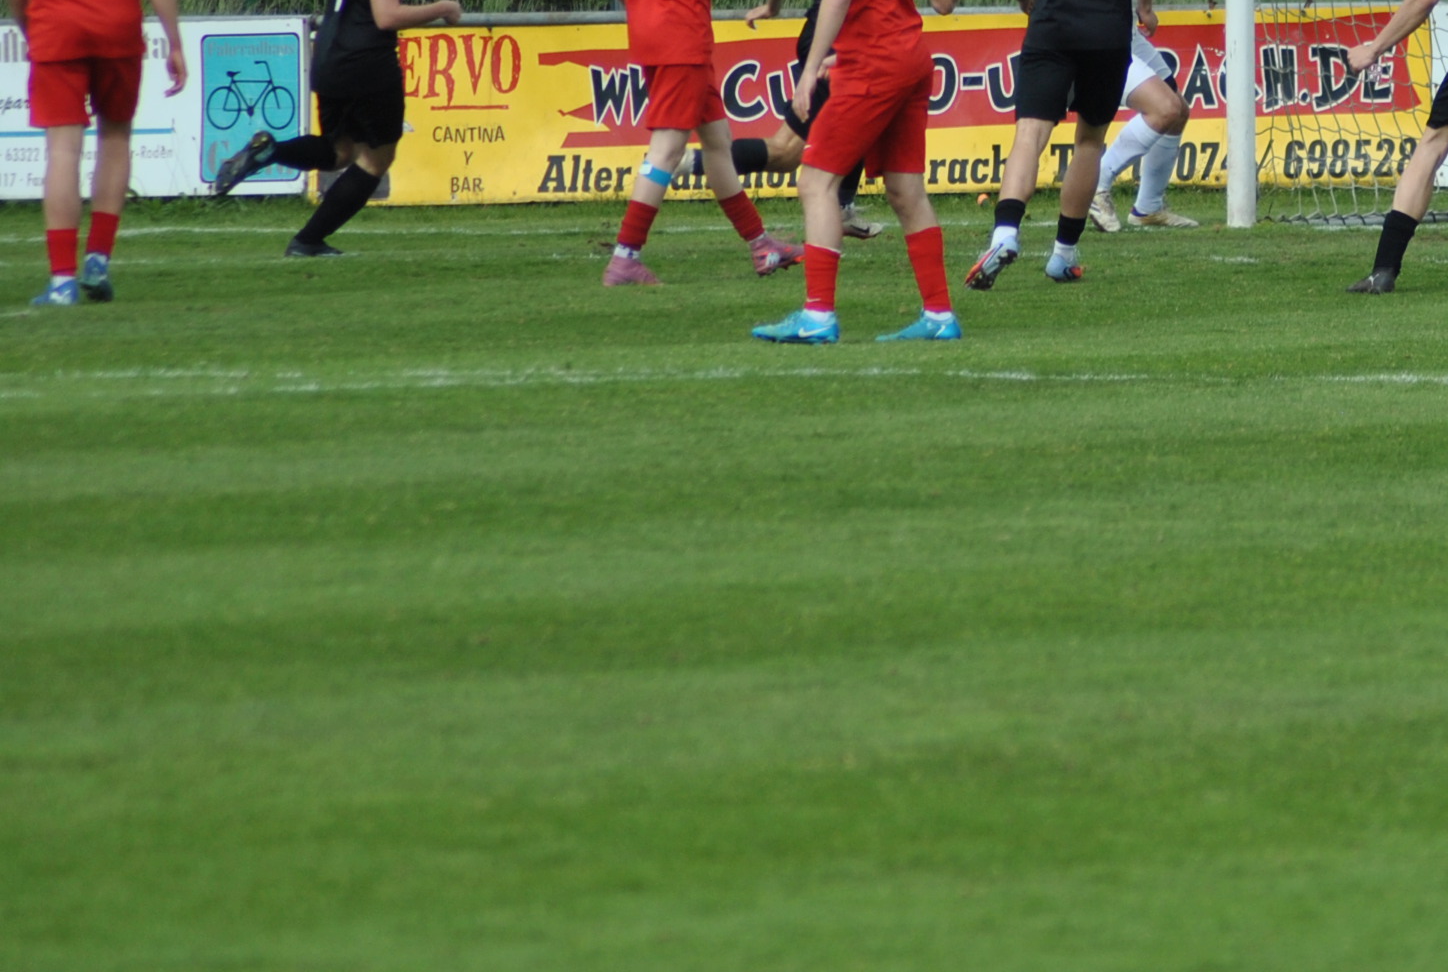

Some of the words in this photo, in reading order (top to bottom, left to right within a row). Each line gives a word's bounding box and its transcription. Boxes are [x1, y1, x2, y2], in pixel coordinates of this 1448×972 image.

[397, 33, 521, 107] ERVO
[432, 125, 505, 144] CANTINA
[463, 150, 474, 166] Y
[1283, 137, 1417, 180] 698528
[451, 176, 484, 194] BAR
[537, 154, 632, 194] Alter
